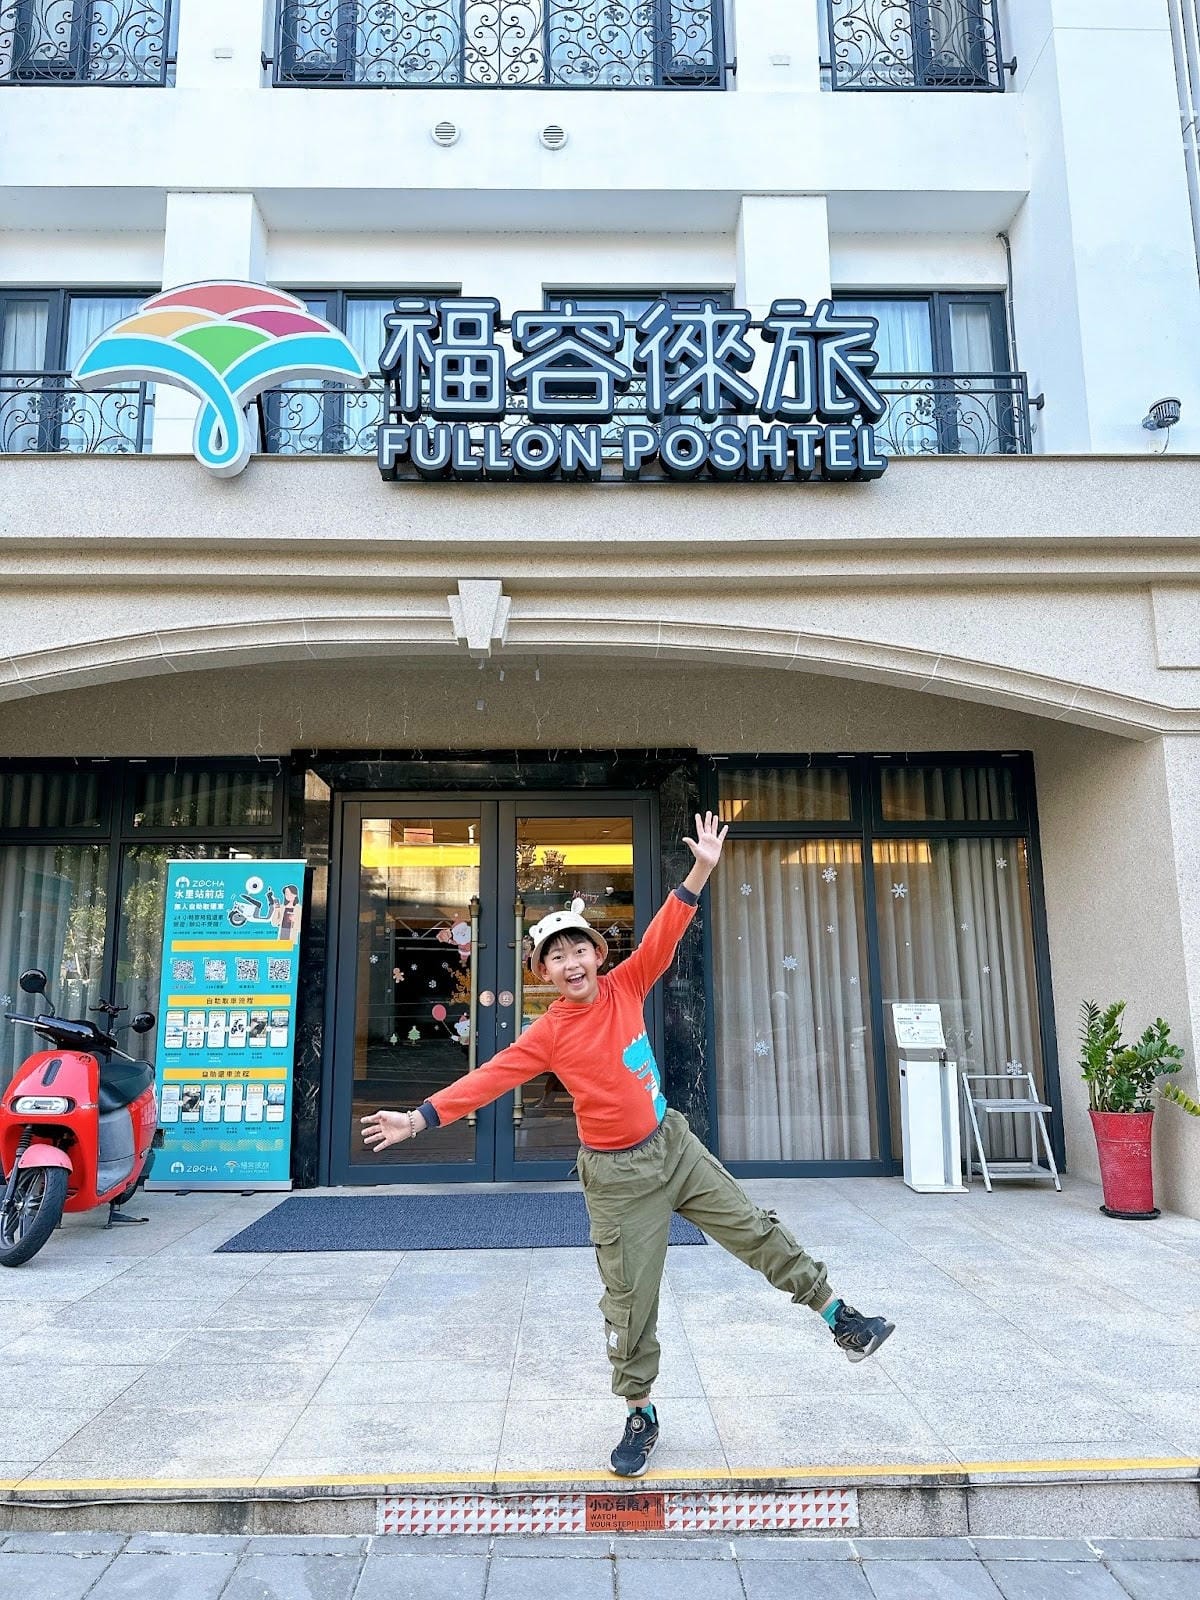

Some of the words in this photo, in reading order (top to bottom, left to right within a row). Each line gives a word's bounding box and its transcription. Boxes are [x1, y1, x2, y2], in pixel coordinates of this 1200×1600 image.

[380, 298, 885, 418] 福容徠旅
[378, 424, 602, 474] FULLON
[624, 424, 888, 474] POSHTEL
[174, 889, 225, 899] 水里站前店
[186, 1165, 218, 1173] ZOCHA
